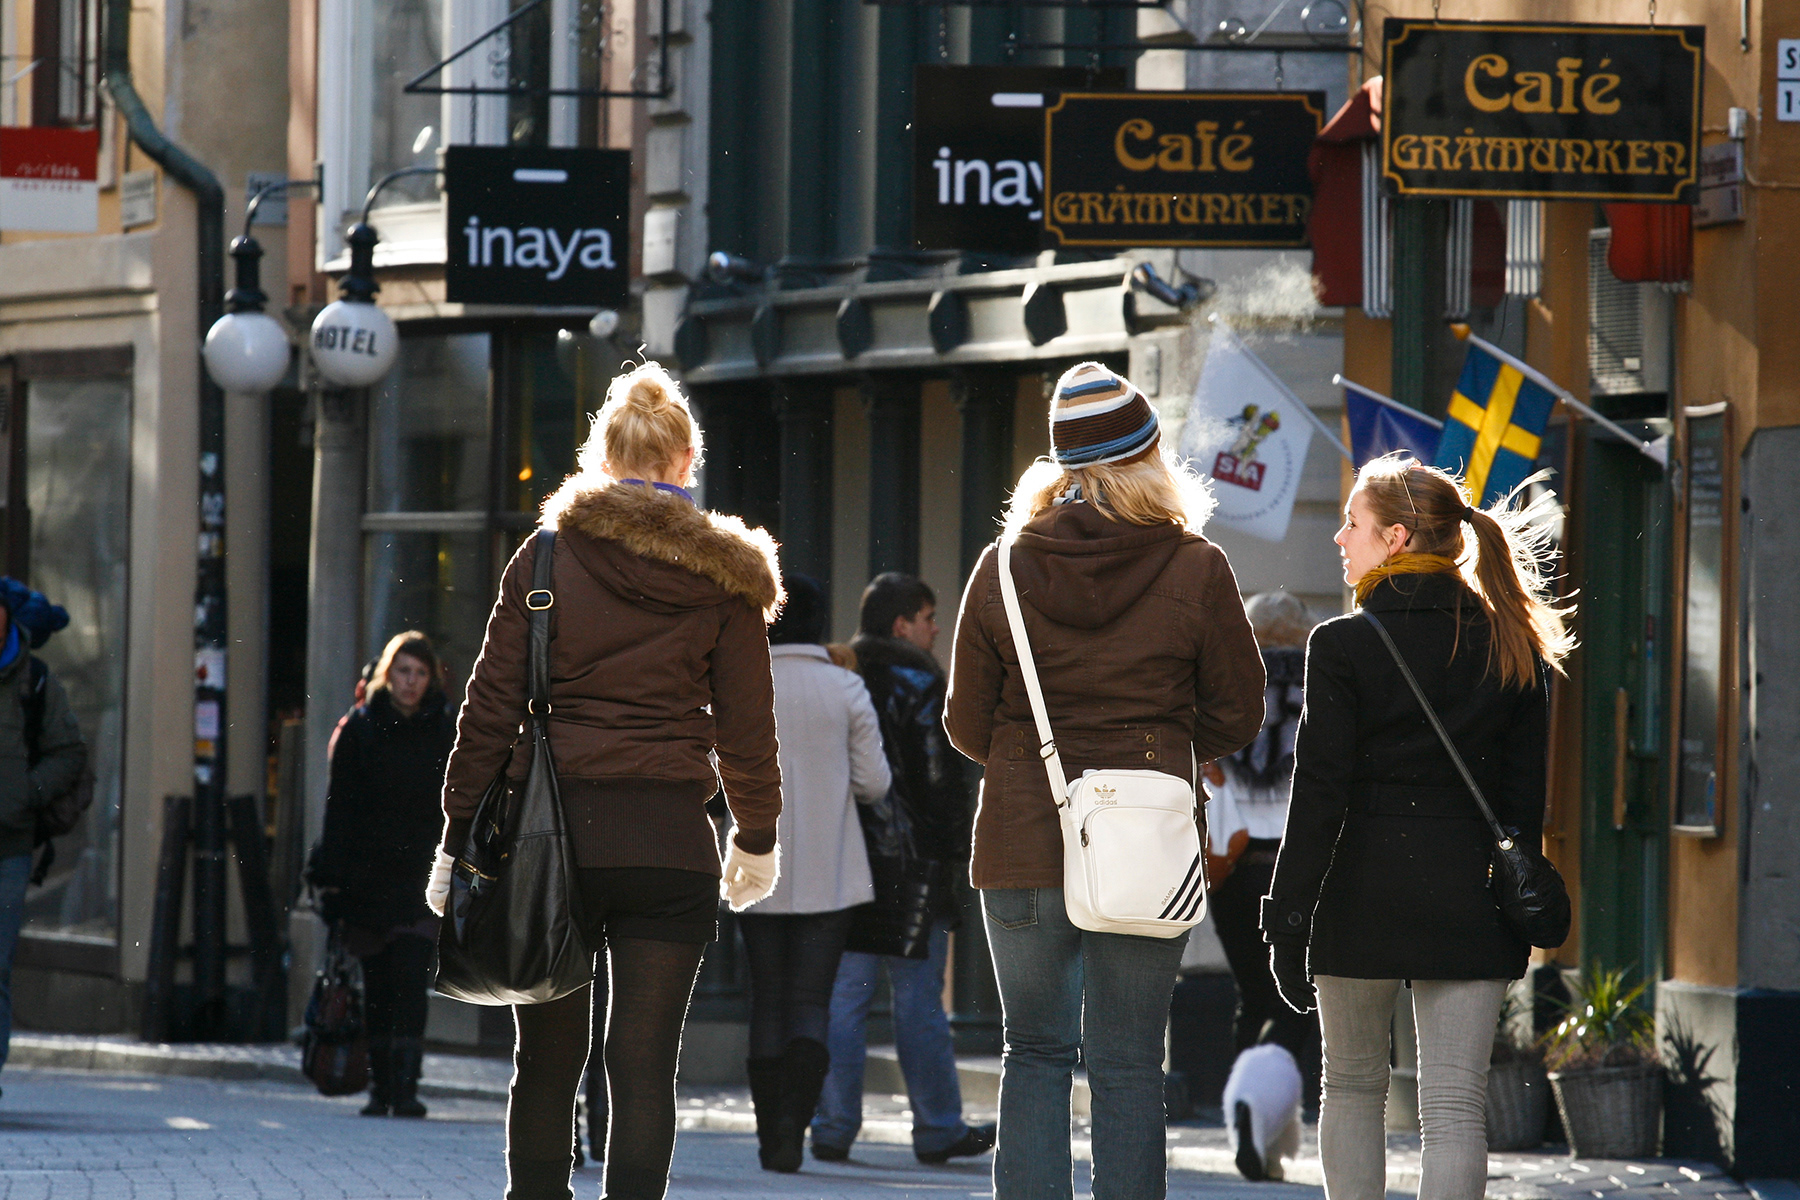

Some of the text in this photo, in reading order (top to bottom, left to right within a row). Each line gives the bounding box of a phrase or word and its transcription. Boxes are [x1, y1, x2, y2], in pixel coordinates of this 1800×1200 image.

[1785, 46, 1800, 69] S
[1465, 53, 1621, 115] Café
[1114, 118, 1254, 172] Café
[1391, 127, 1688, 175] GRÅMUNKEN
[463, 215, 617, 281] inaya
[314, 325, 378, 357] HOTEL
[1161, 886, 1176, 906] SAMBA
